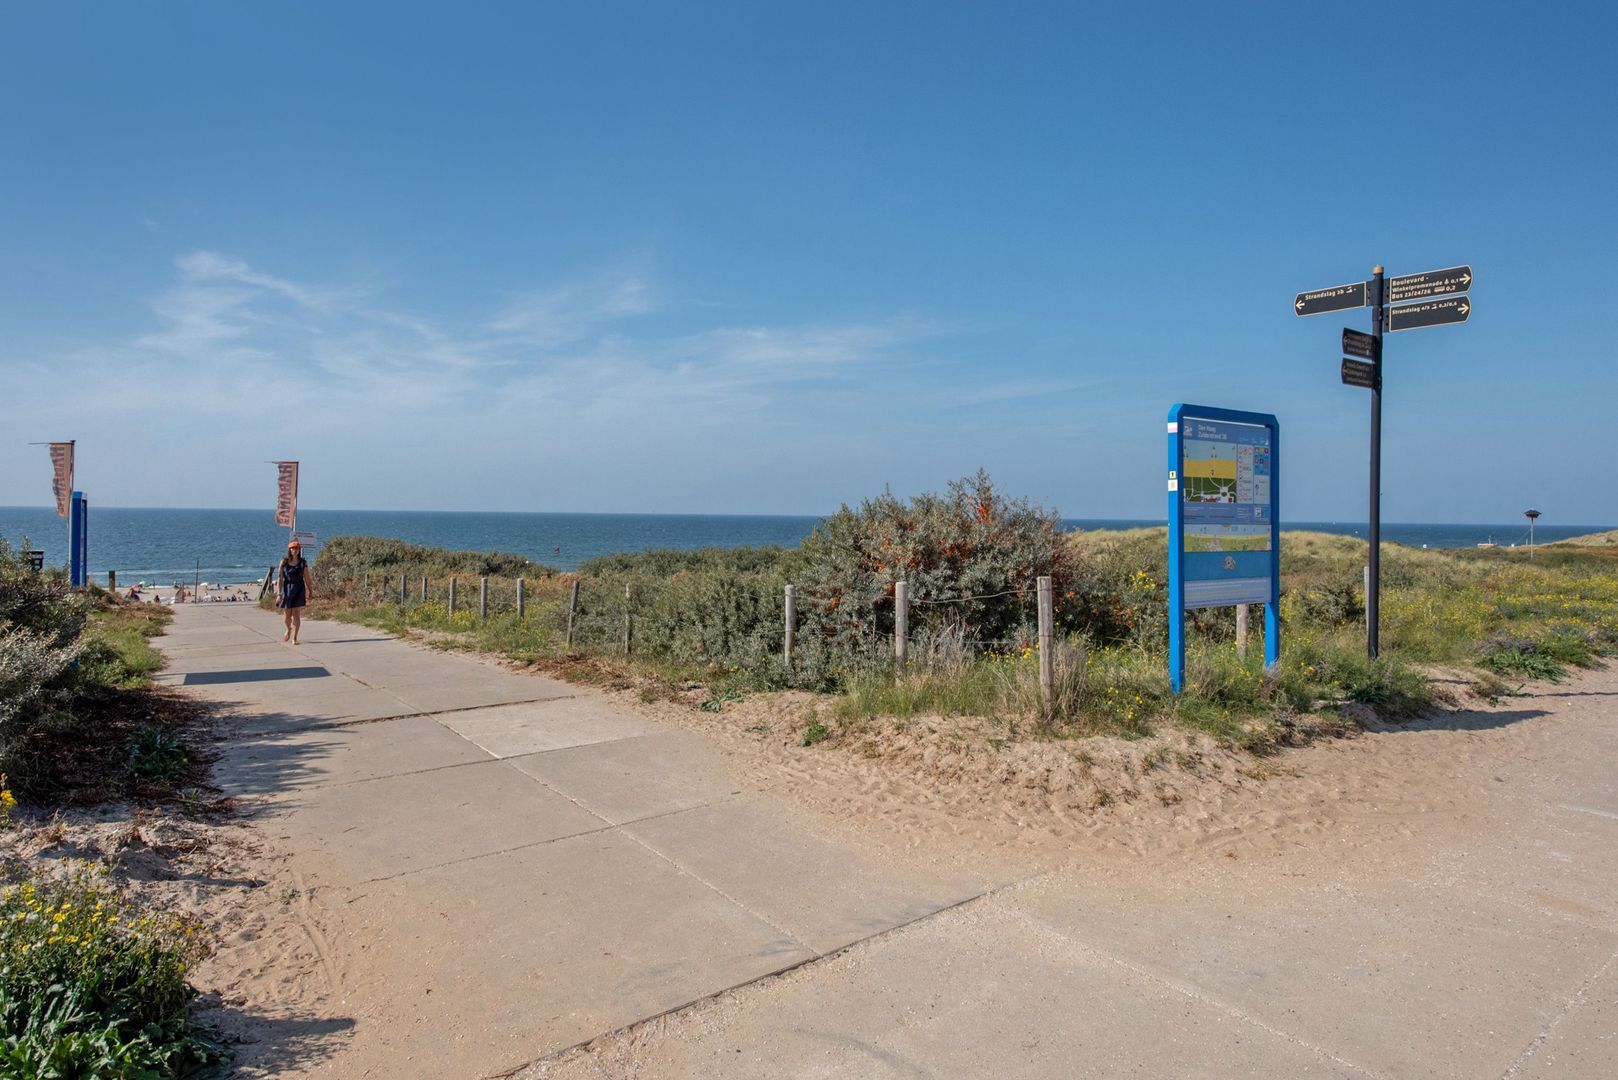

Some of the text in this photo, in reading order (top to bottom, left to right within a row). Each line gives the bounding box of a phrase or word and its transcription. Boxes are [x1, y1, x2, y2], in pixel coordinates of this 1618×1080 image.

[1392, 276, 1424, 287] Boulevard
[1392, 281, 1443, 293] Winkelpromenade
[1305, 290, 1336, 300] Strandslag
[1392, 306, 1420, 315] Strandslag
